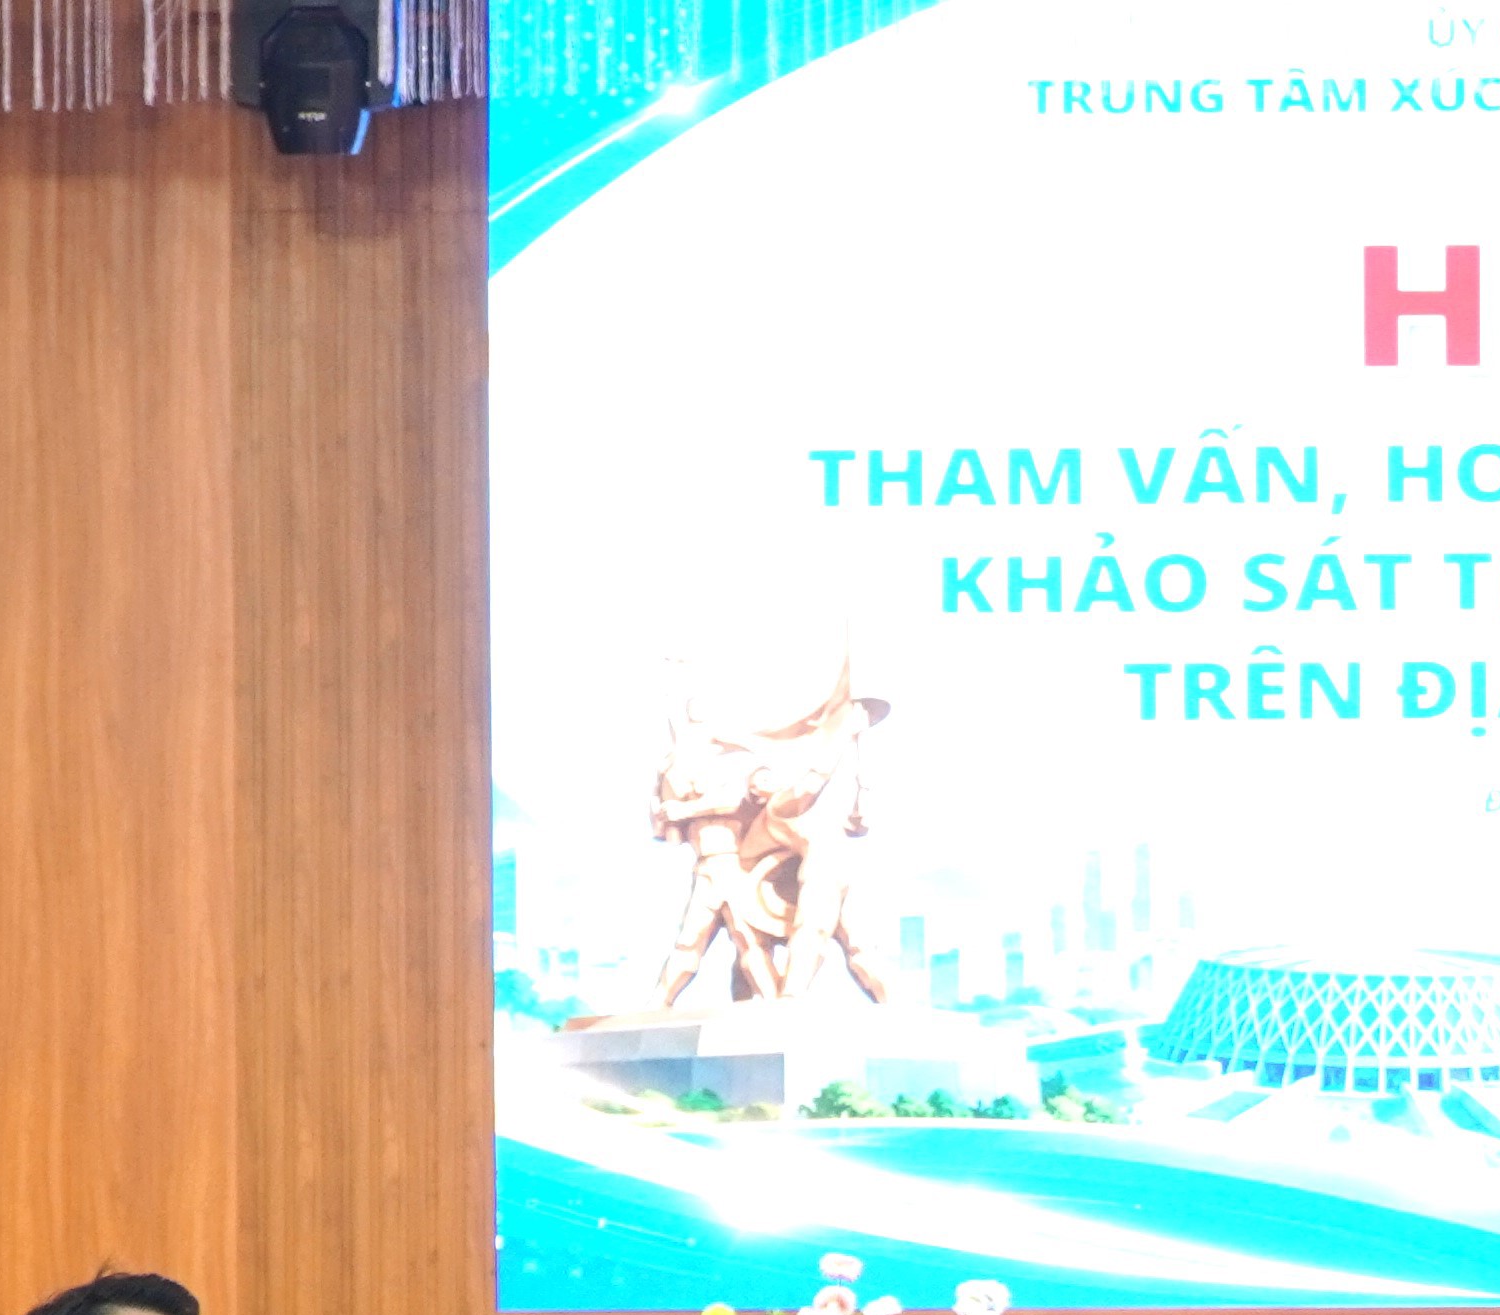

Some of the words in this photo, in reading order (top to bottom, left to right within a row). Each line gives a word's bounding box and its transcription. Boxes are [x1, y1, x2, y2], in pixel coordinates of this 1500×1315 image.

[1027, 77, 1224, 115] TRUNG
[1246, 66, 1367, 113] TÂM
[809, 448, 1081, 507] THAM
[1119, 427, 1348, 515] VẤN,
[942, 533, 1207, 613] KHẢO
[1243, 536, 1412, 612] SÁT
[1124, 645, 1361, 721] TRÊN
